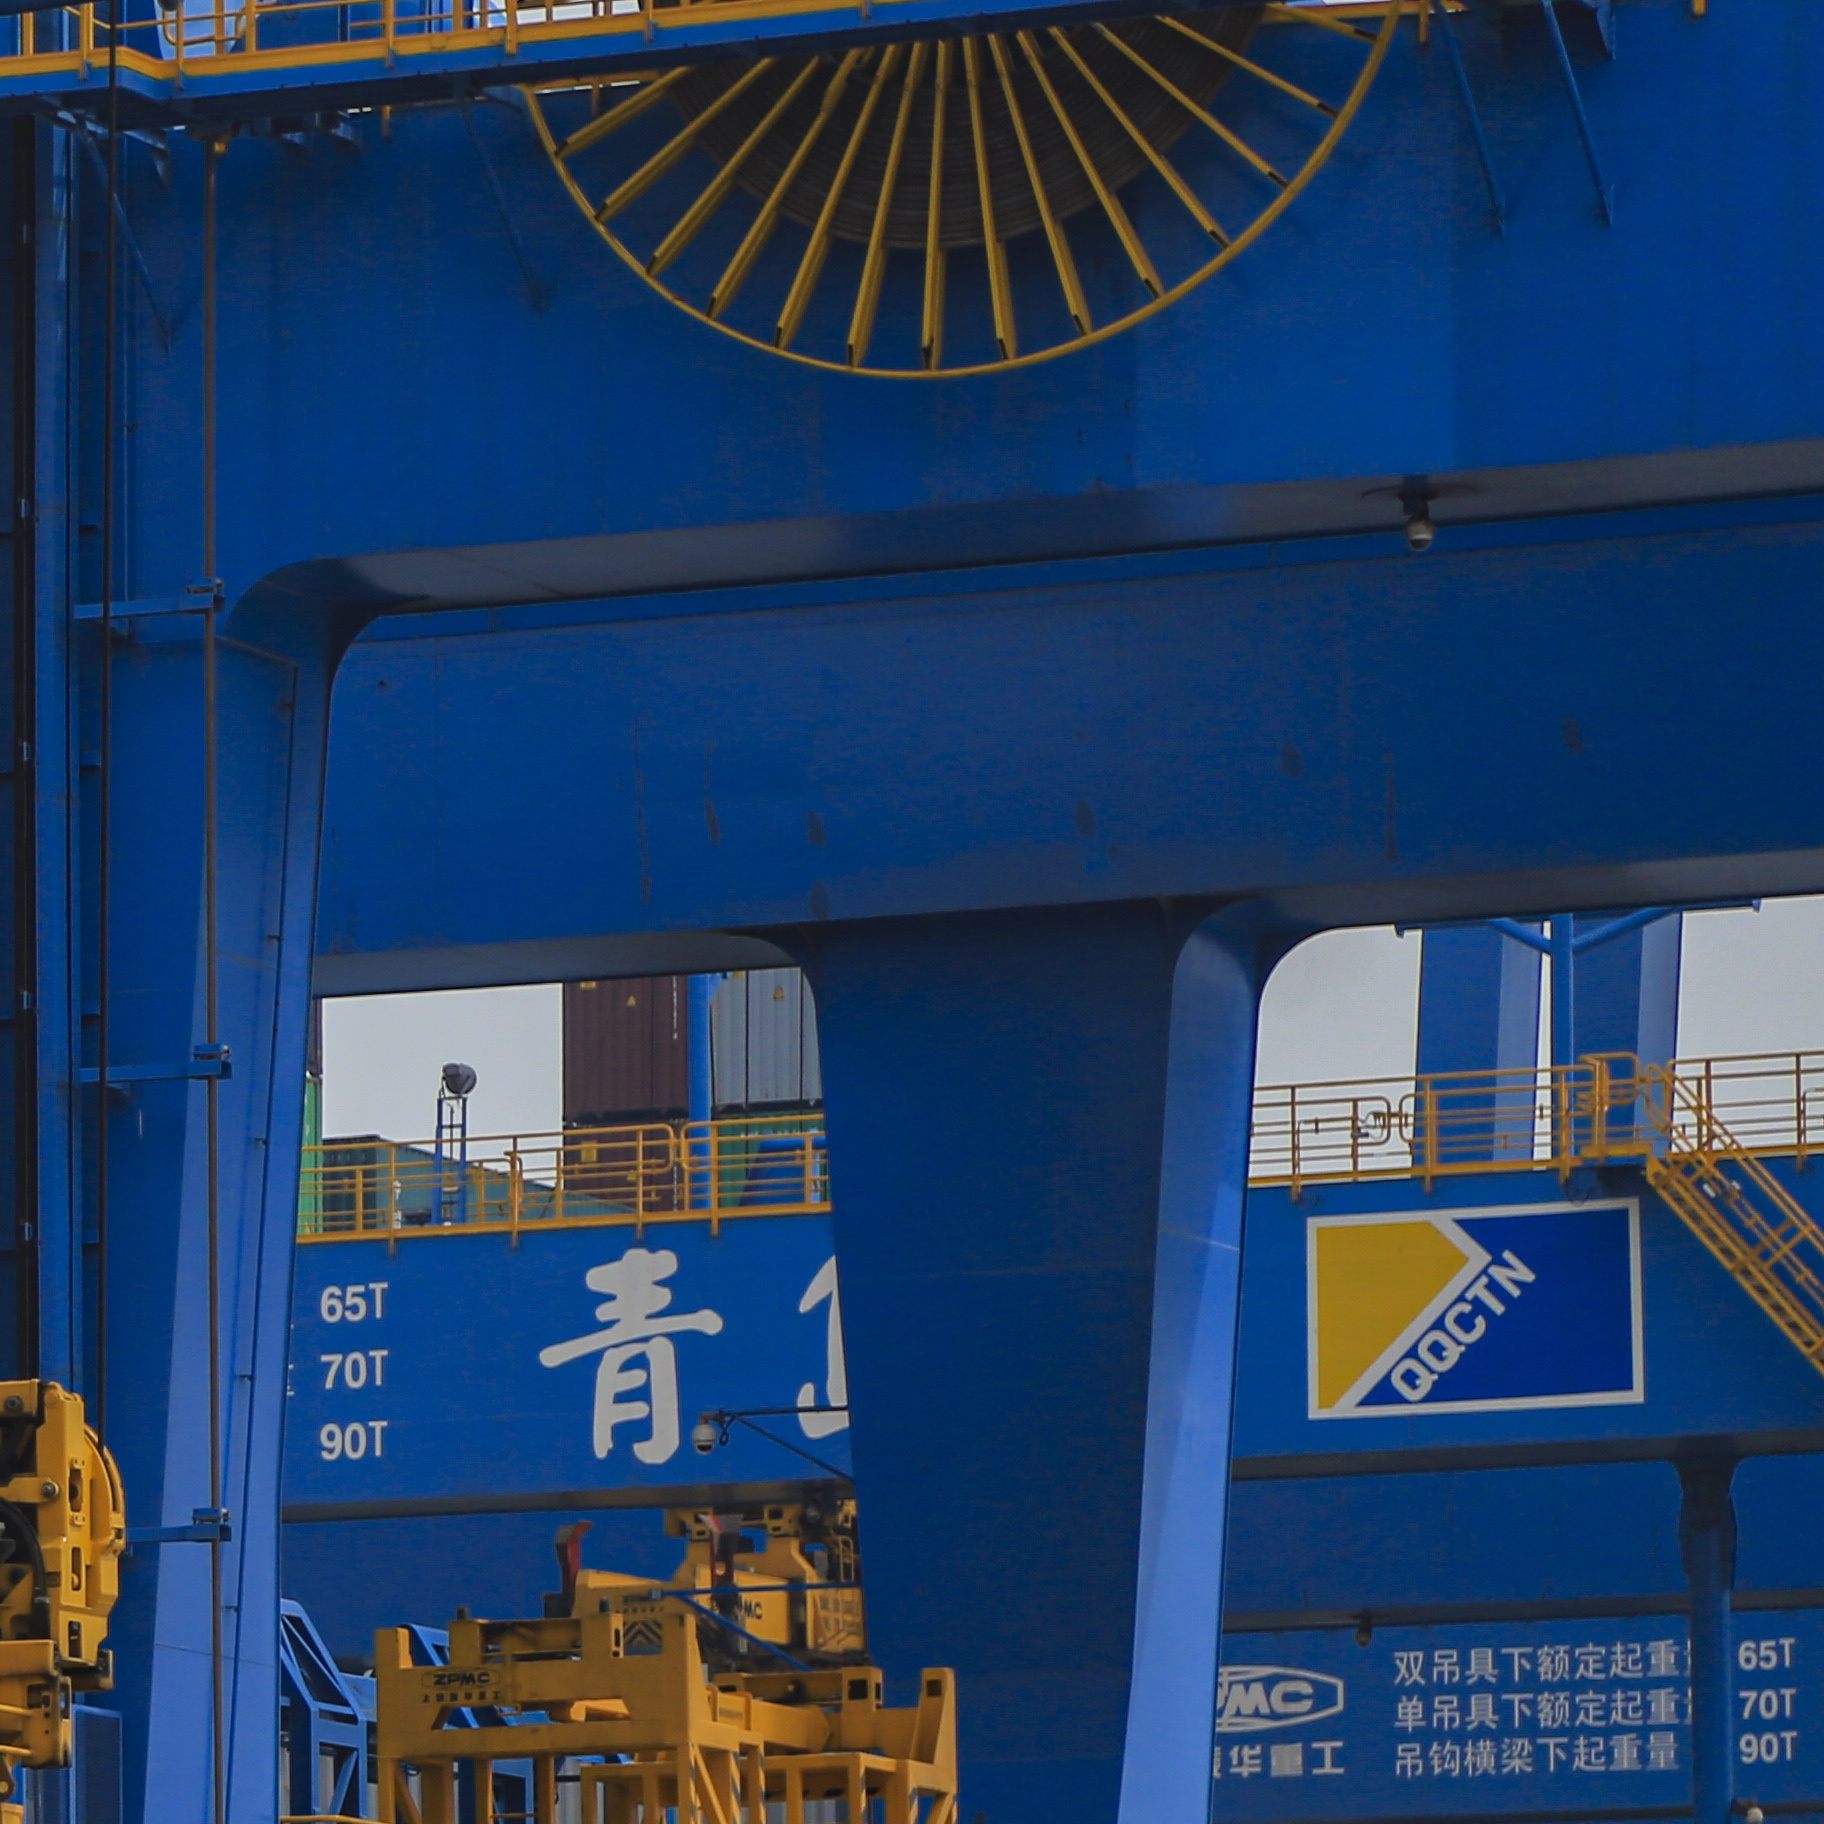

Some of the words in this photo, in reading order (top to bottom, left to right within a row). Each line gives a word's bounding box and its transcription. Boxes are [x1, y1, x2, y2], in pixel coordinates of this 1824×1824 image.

[320, 1281, 389, 1324] 65T
[1390, 1249, 1536, 1402] QQCTN
[320, 1349, 389, 1390] 70T
[320, 1420, 389, 1461] 90T
[1738, 1637, 1796, 1671] 65T
[1216, 1680, 1314, 1716] MC
[1738, 1687, 1797, 1721] 70T
[1738, 1731, 1798, 1765] 90T
